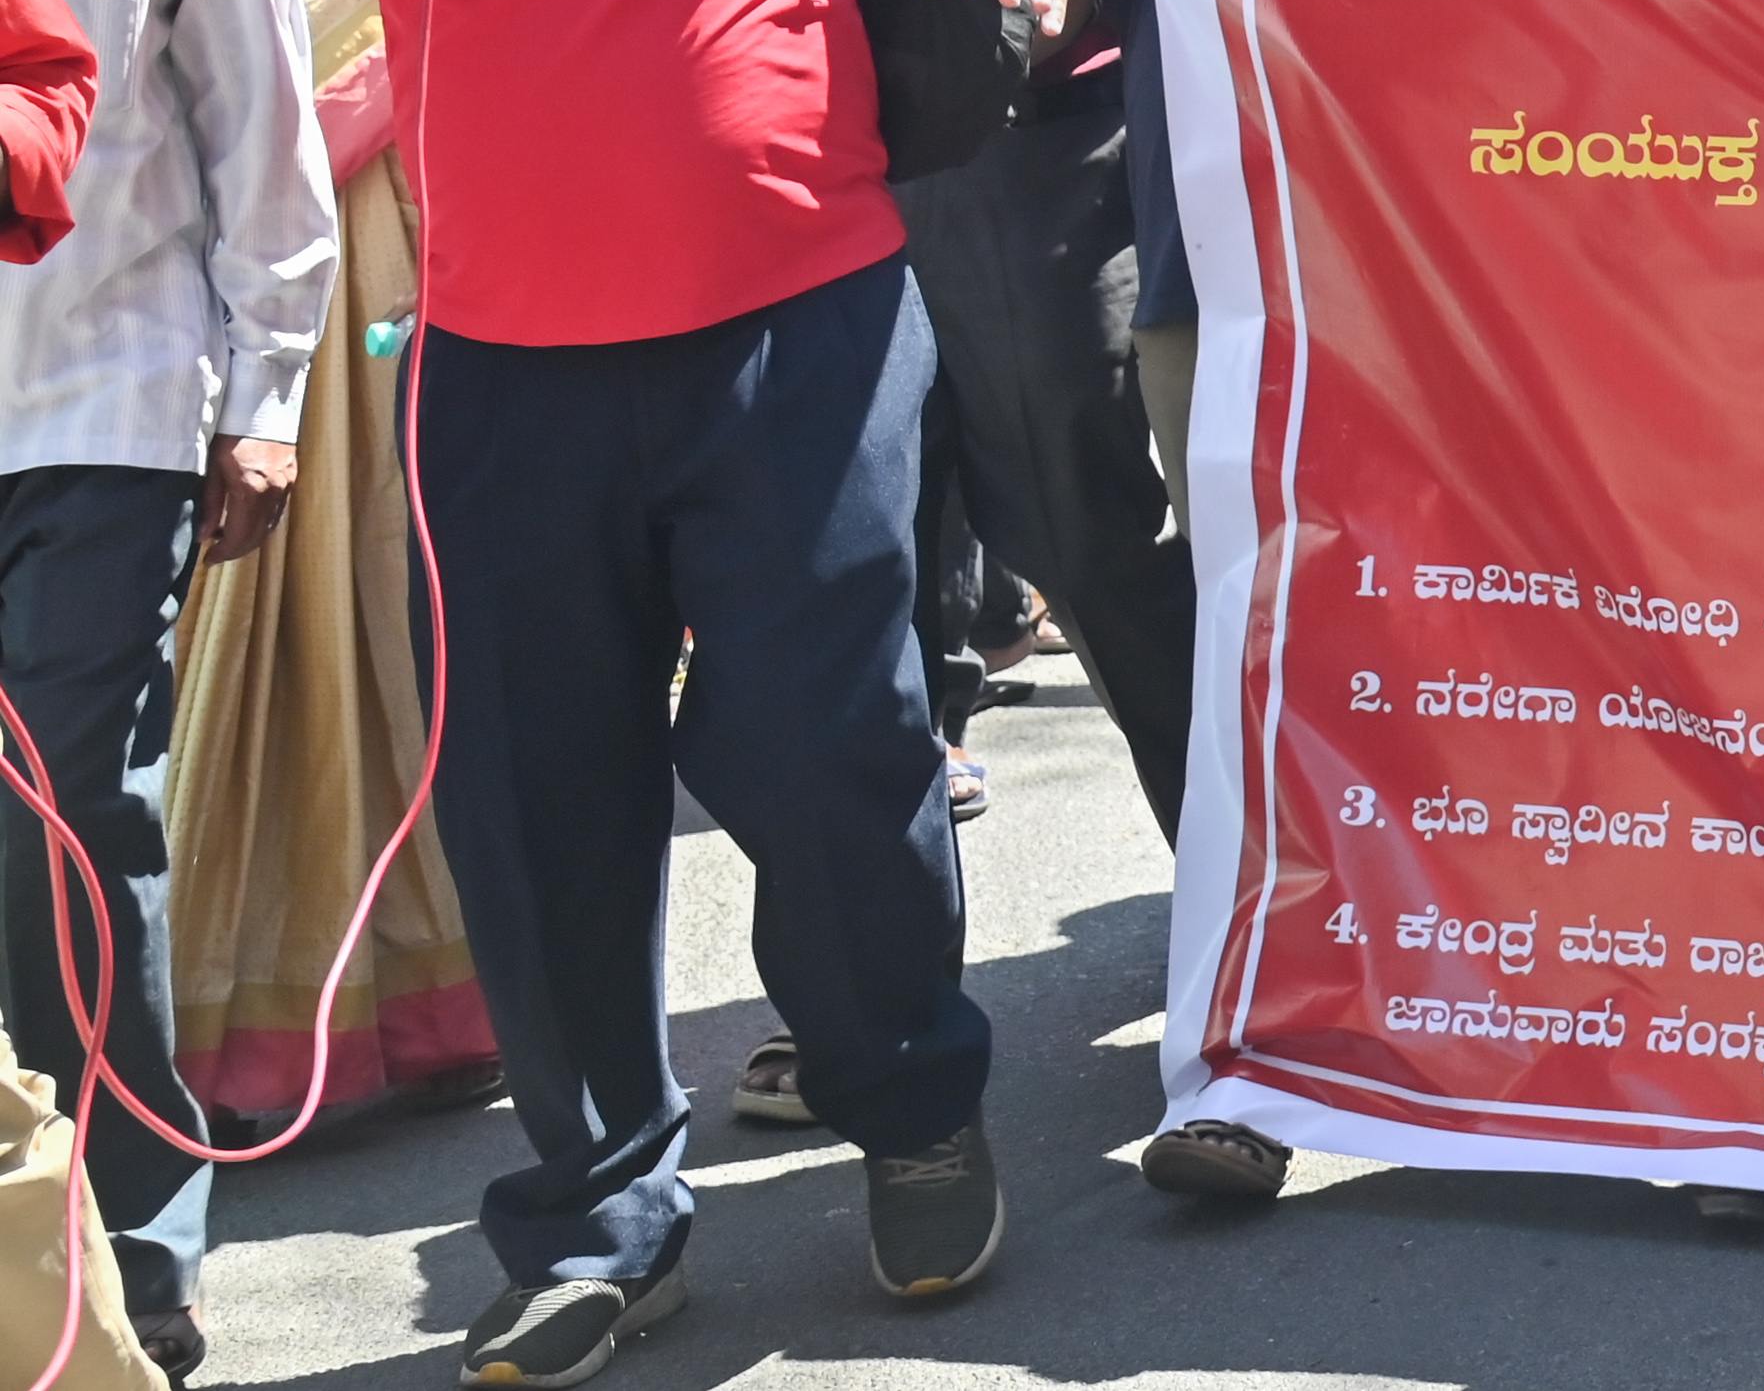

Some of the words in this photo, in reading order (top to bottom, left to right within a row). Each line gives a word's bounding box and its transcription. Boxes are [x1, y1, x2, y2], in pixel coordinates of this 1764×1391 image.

[1469, 111, 1760, 207] ಸಂಯುಕ್ತ
[1355, 555, 1388, 598] 1.
[1412, 563, 1581, 610] ಕಾರ್ಮಿಕ
[1594, 585, 1740, 647] ವಿರೋಧಿ
[1348, 670, 1393, 714] 2.
[1415, 668, 1577, 723] ನರೇಗಾ
[1339, 785, 1387, 829] 3.
[1411, 784, 1490, 842] ಭೂ
[1511, 800, 1671, 865] ಸ್ವಾದೀನ
[1324, 902, 1370, 945] 4.
[1395, 903, 1539, 975] ಕೇಂದ್ರ
[1384, 988, 1626, 1049] ಜಾನುವಾರು
